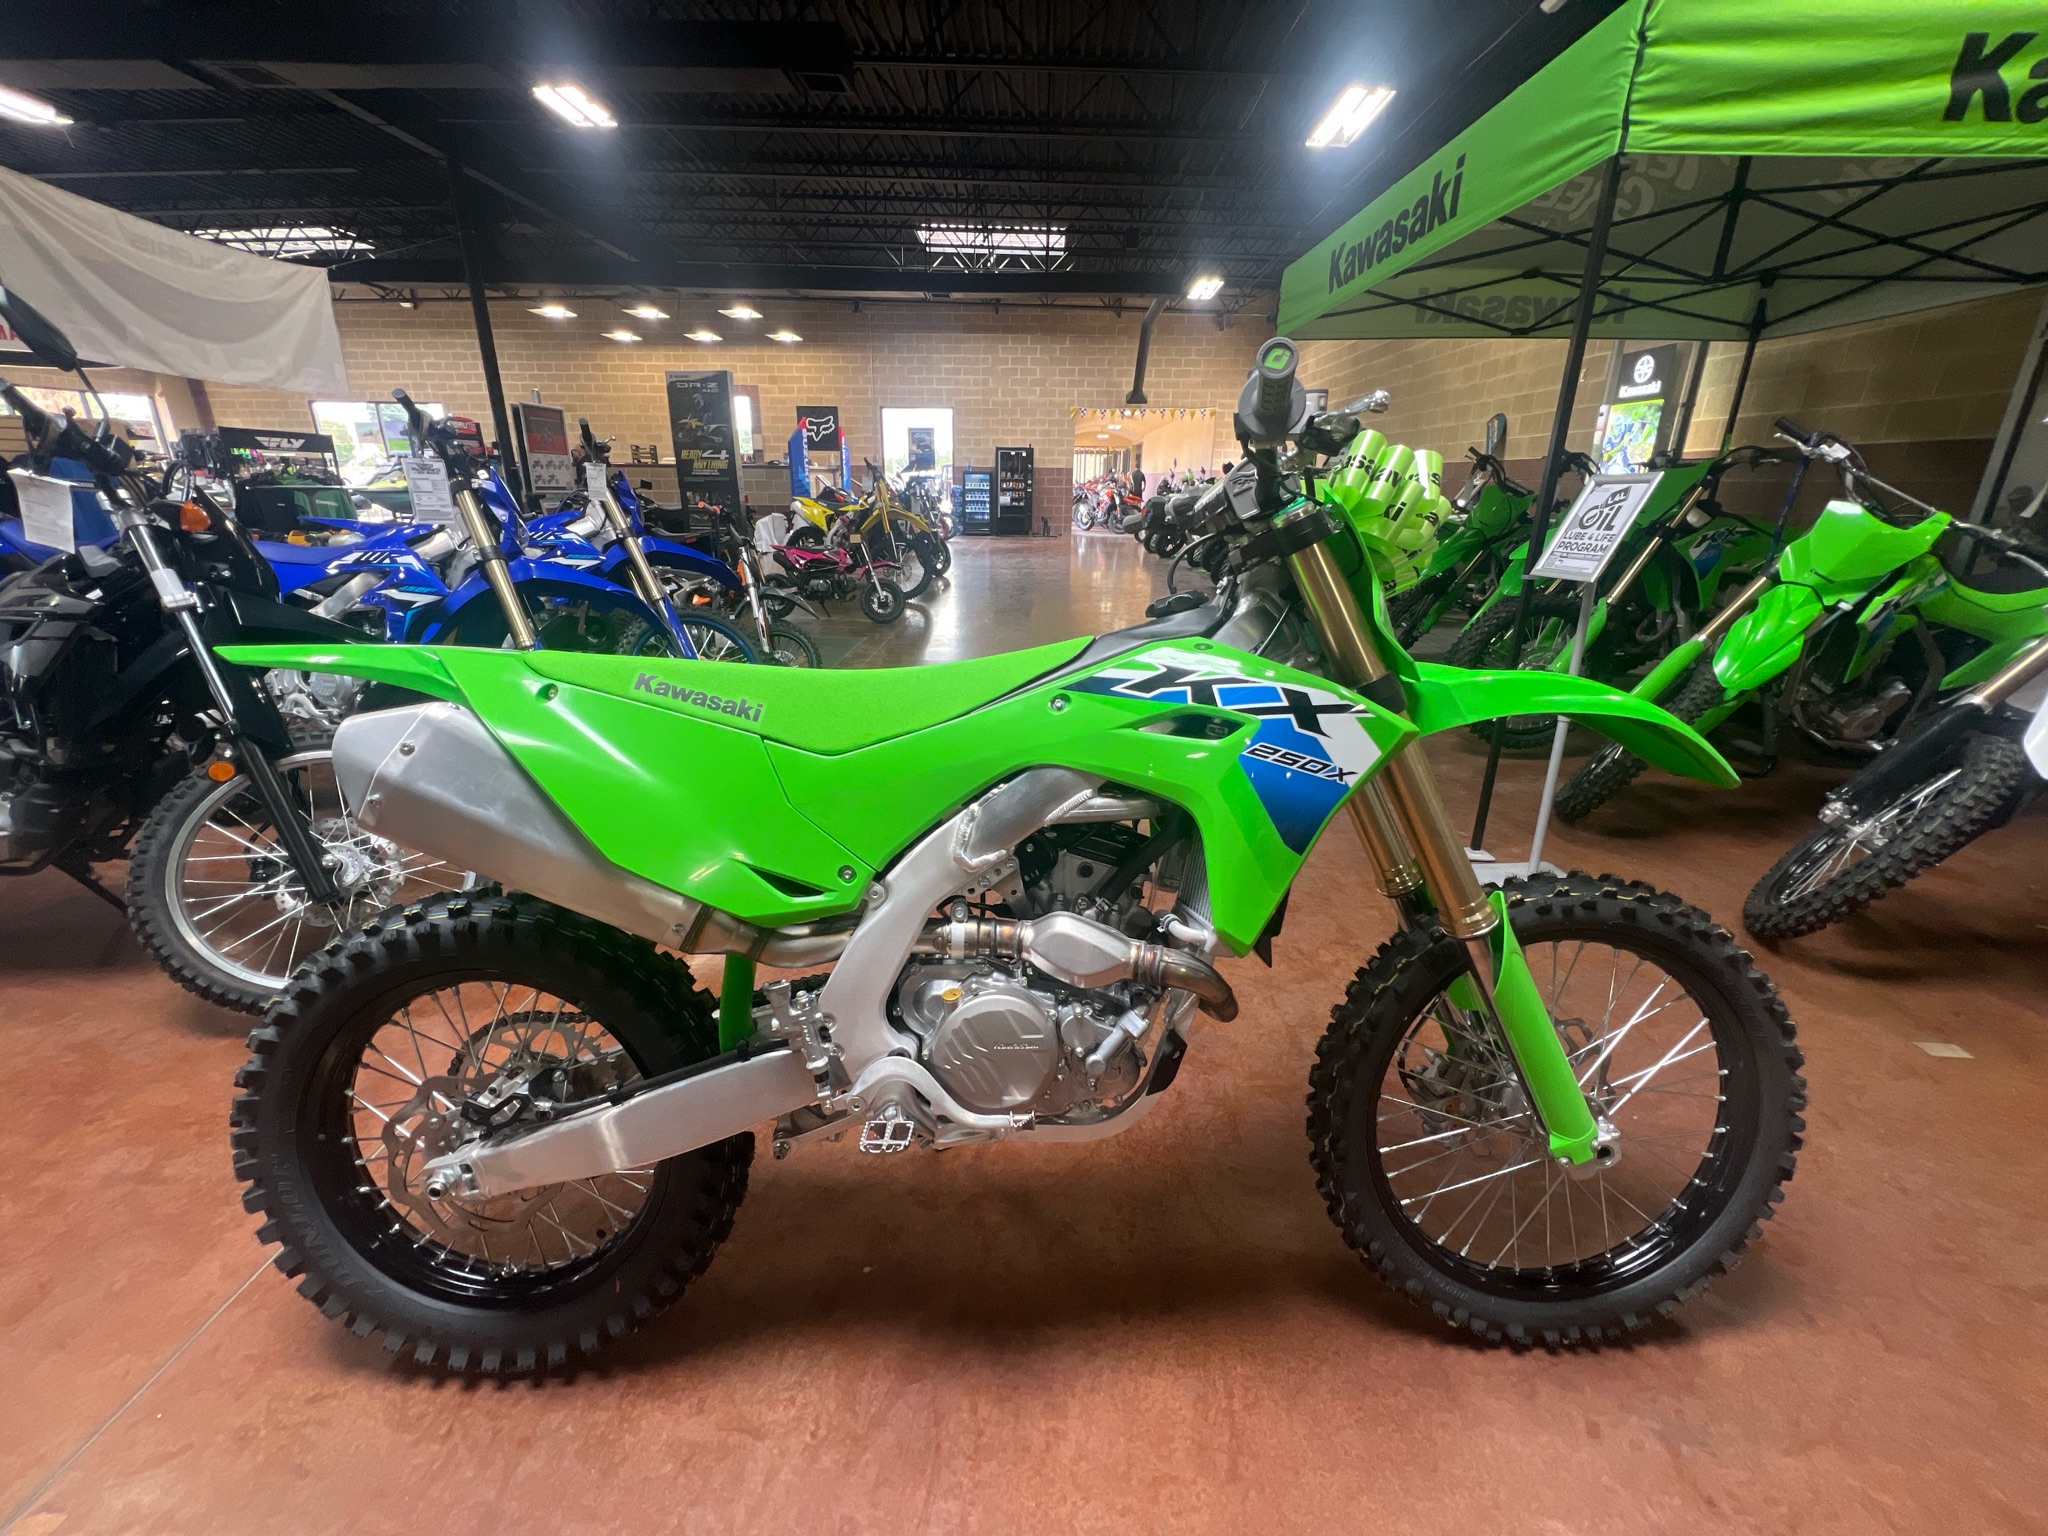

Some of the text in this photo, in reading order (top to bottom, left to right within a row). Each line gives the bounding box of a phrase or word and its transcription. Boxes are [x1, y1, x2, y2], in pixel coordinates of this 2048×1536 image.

[1329, 152, 1466, 295] Kawasaki
[701, 449, 729, 460] 4
[1557, 541, 1609, 554] PROGRAM
[1563, 531, 1588, 541] LUBE
[1595, 533, 1617, 543] LIFE
[633, 672, 763, 723] Kawasaki
[1112, 663, 1372, 739] KX
